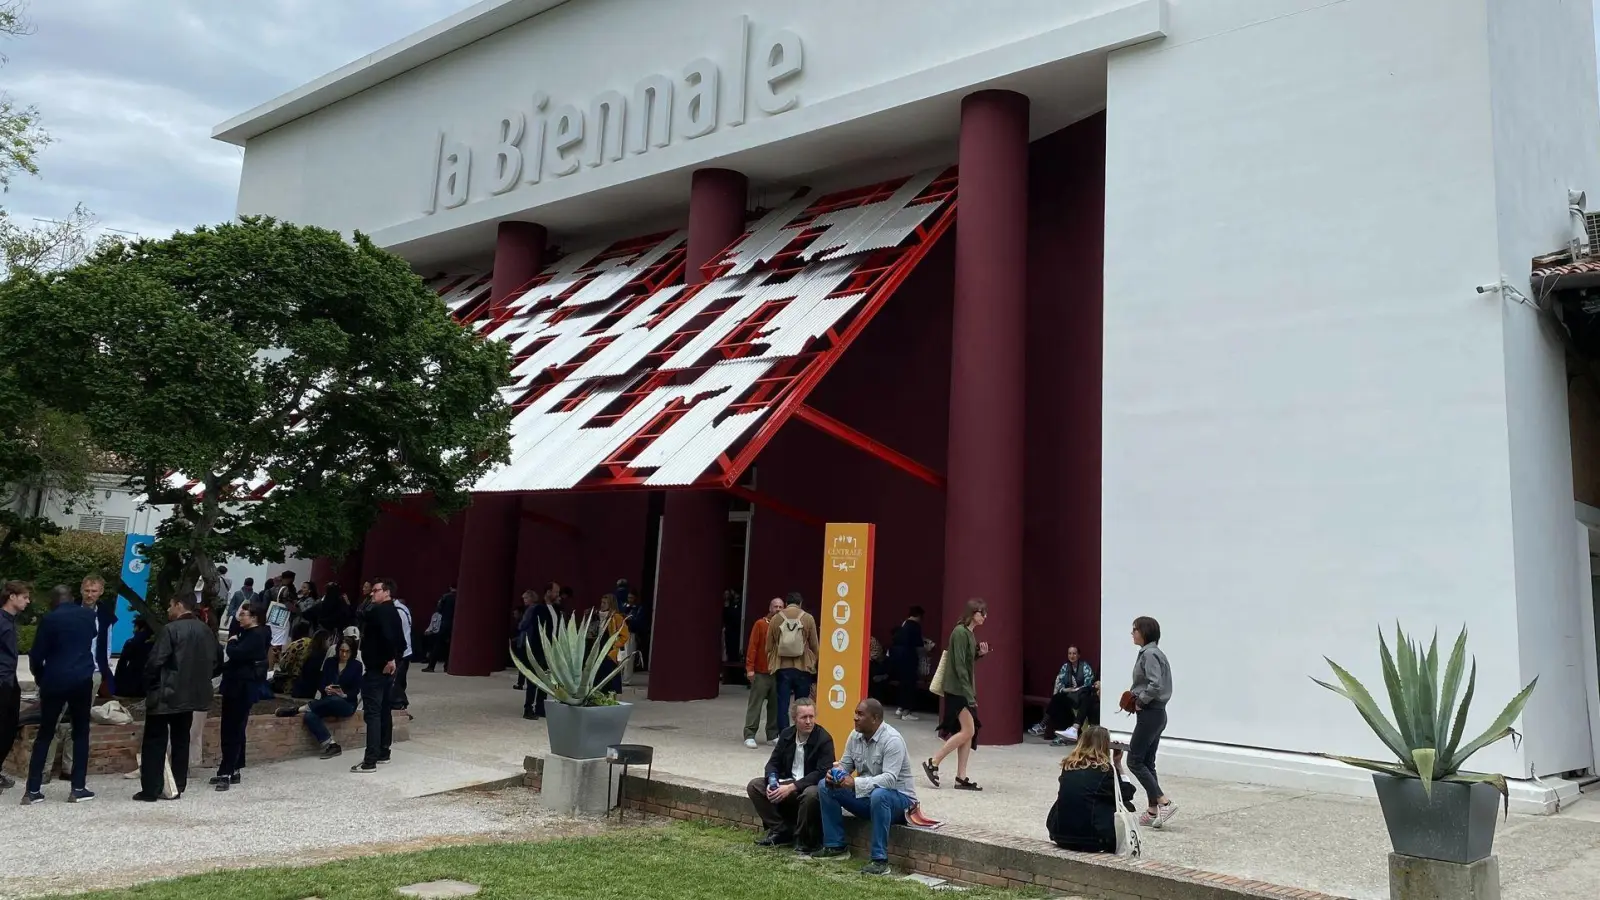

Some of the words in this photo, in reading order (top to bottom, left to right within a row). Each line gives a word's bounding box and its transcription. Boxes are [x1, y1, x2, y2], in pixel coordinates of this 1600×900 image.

[424, 129, 472, 214] la
[490, 14, 803, 195] Biennale
[827, 548, 863, 556] CENTRALE
